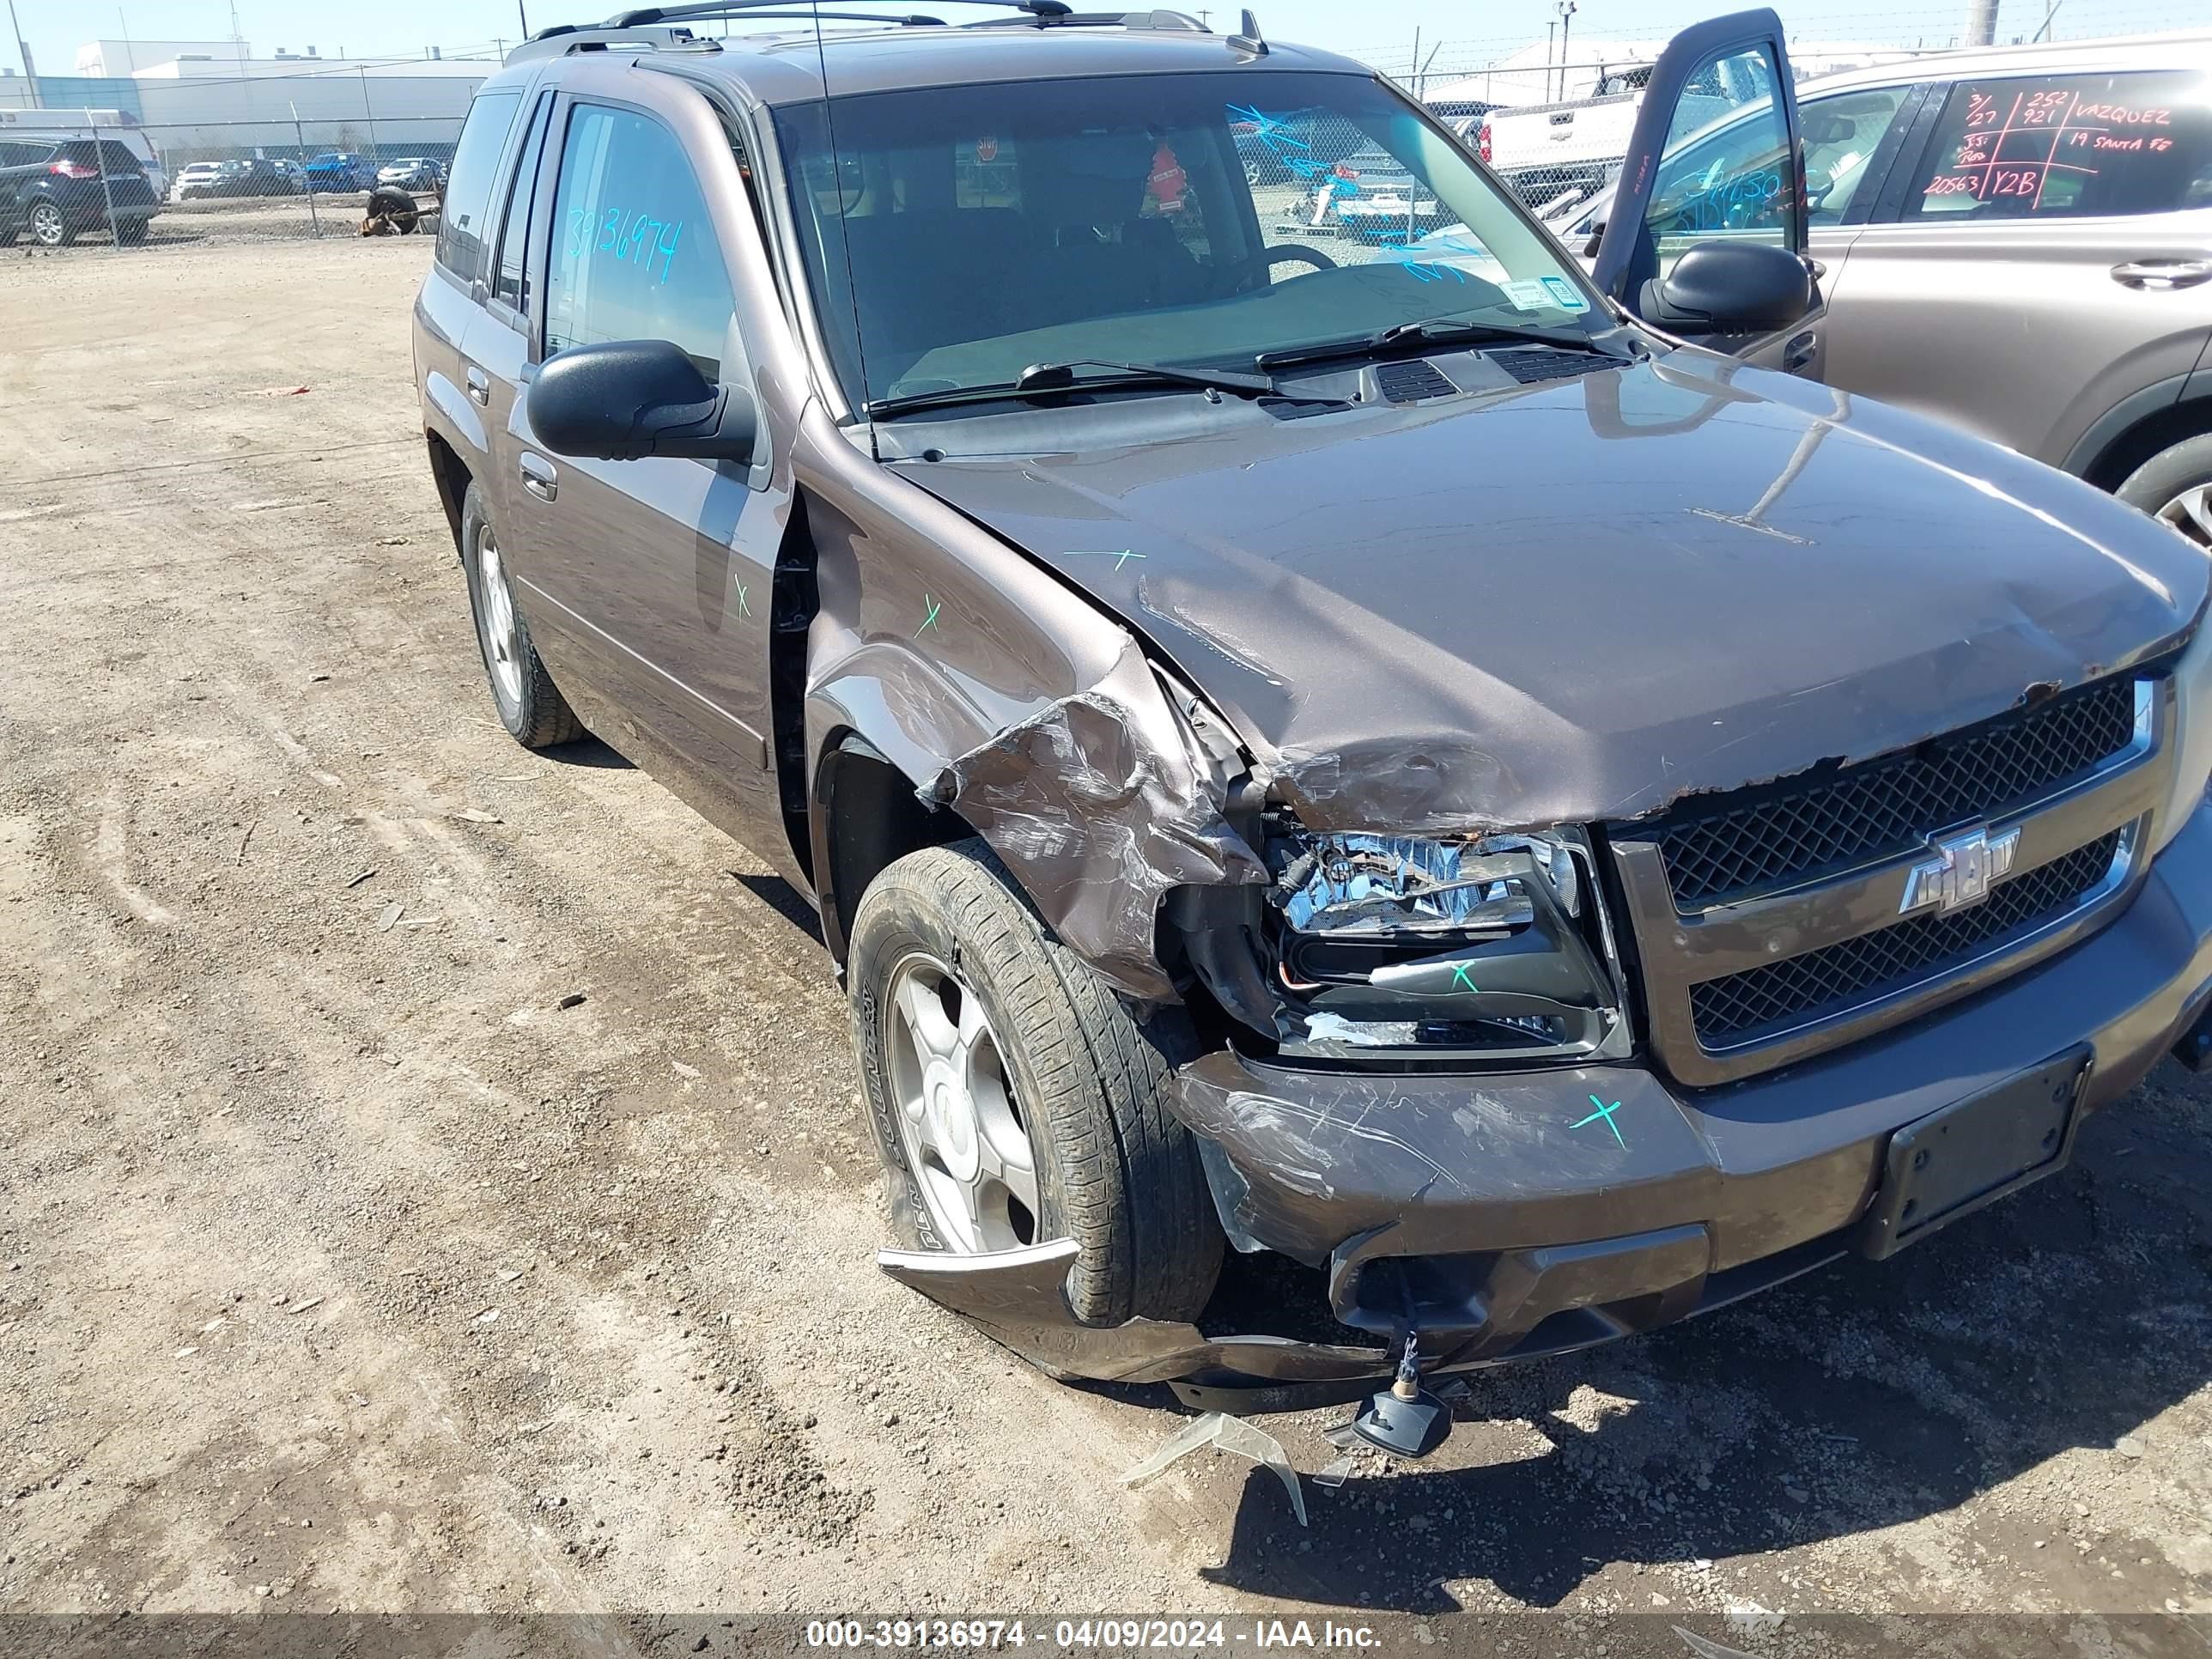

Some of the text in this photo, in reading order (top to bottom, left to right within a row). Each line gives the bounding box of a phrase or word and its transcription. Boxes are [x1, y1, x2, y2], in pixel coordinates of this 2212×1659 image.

[2027, 91, 2068, 107] 252
[2023, 108, 2055, 124] 921
[2076, 104, 2171, 125] VAZQUEZ
[2070, 132, 2087, 147] 19
[2094, 137, 2143, 150] SANTA
[1923, 175, 1979, 194] 20563
[1992, 171, 2036, 196] Y2B
[569, 208, 683, 284] 39136974
[907, 1182, 944, 1250] PEN
